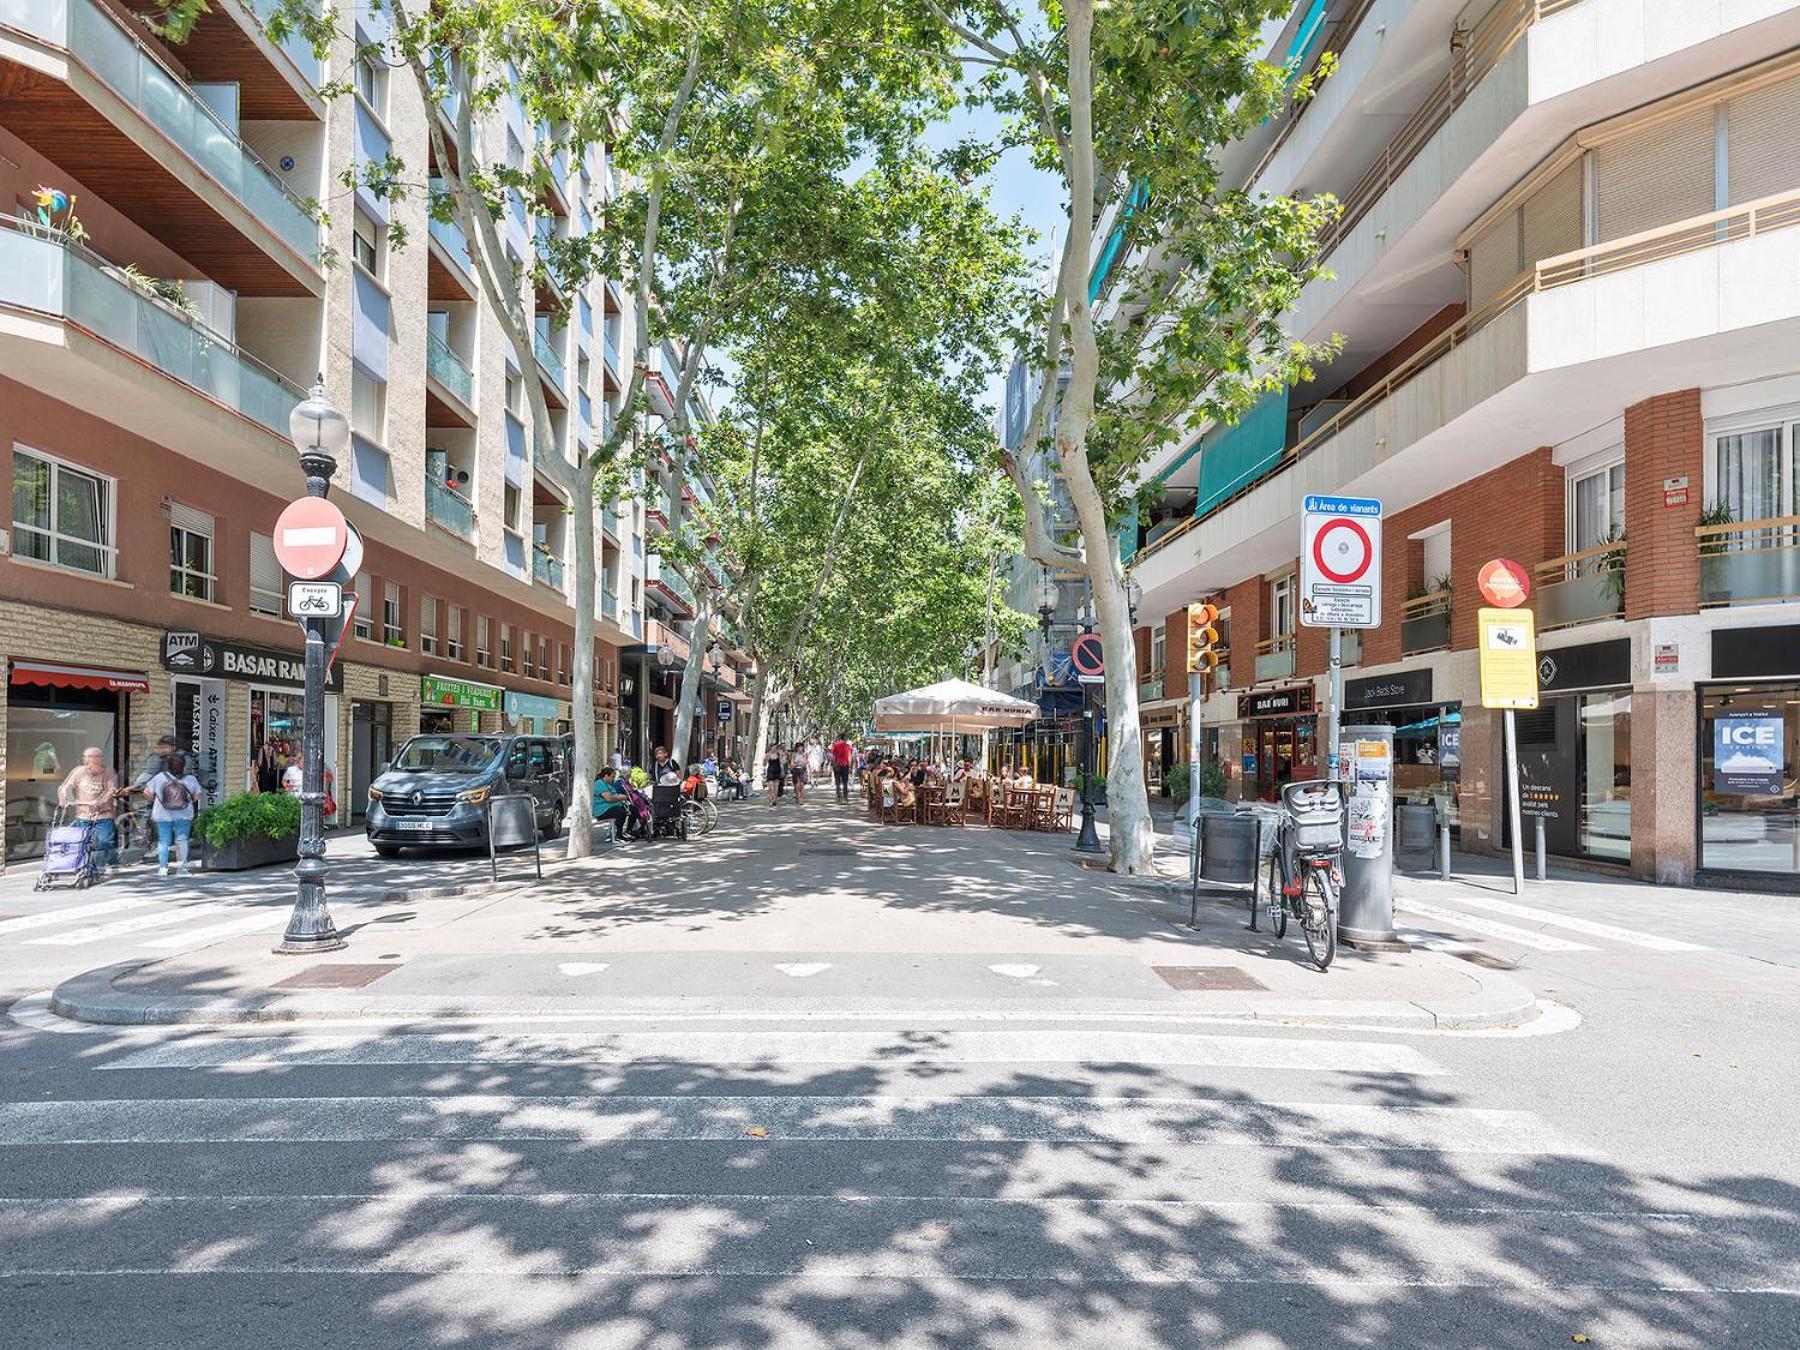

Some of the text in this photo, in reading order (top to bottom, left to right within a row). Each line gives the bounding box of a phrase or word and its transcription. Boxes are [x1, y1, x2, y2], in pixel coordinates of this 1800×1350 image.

[1338, 503, 1347, 512] de
[1350, 504, 1378, 514] vianants
[169, 635, 198, 647] ATM
[223, 652, 277, 678] BASAR
[208, 707, 219, 742] Caixer
[1441, 733, 1459, 746] ICE
[1722, 726, 1775, 745] ICE
